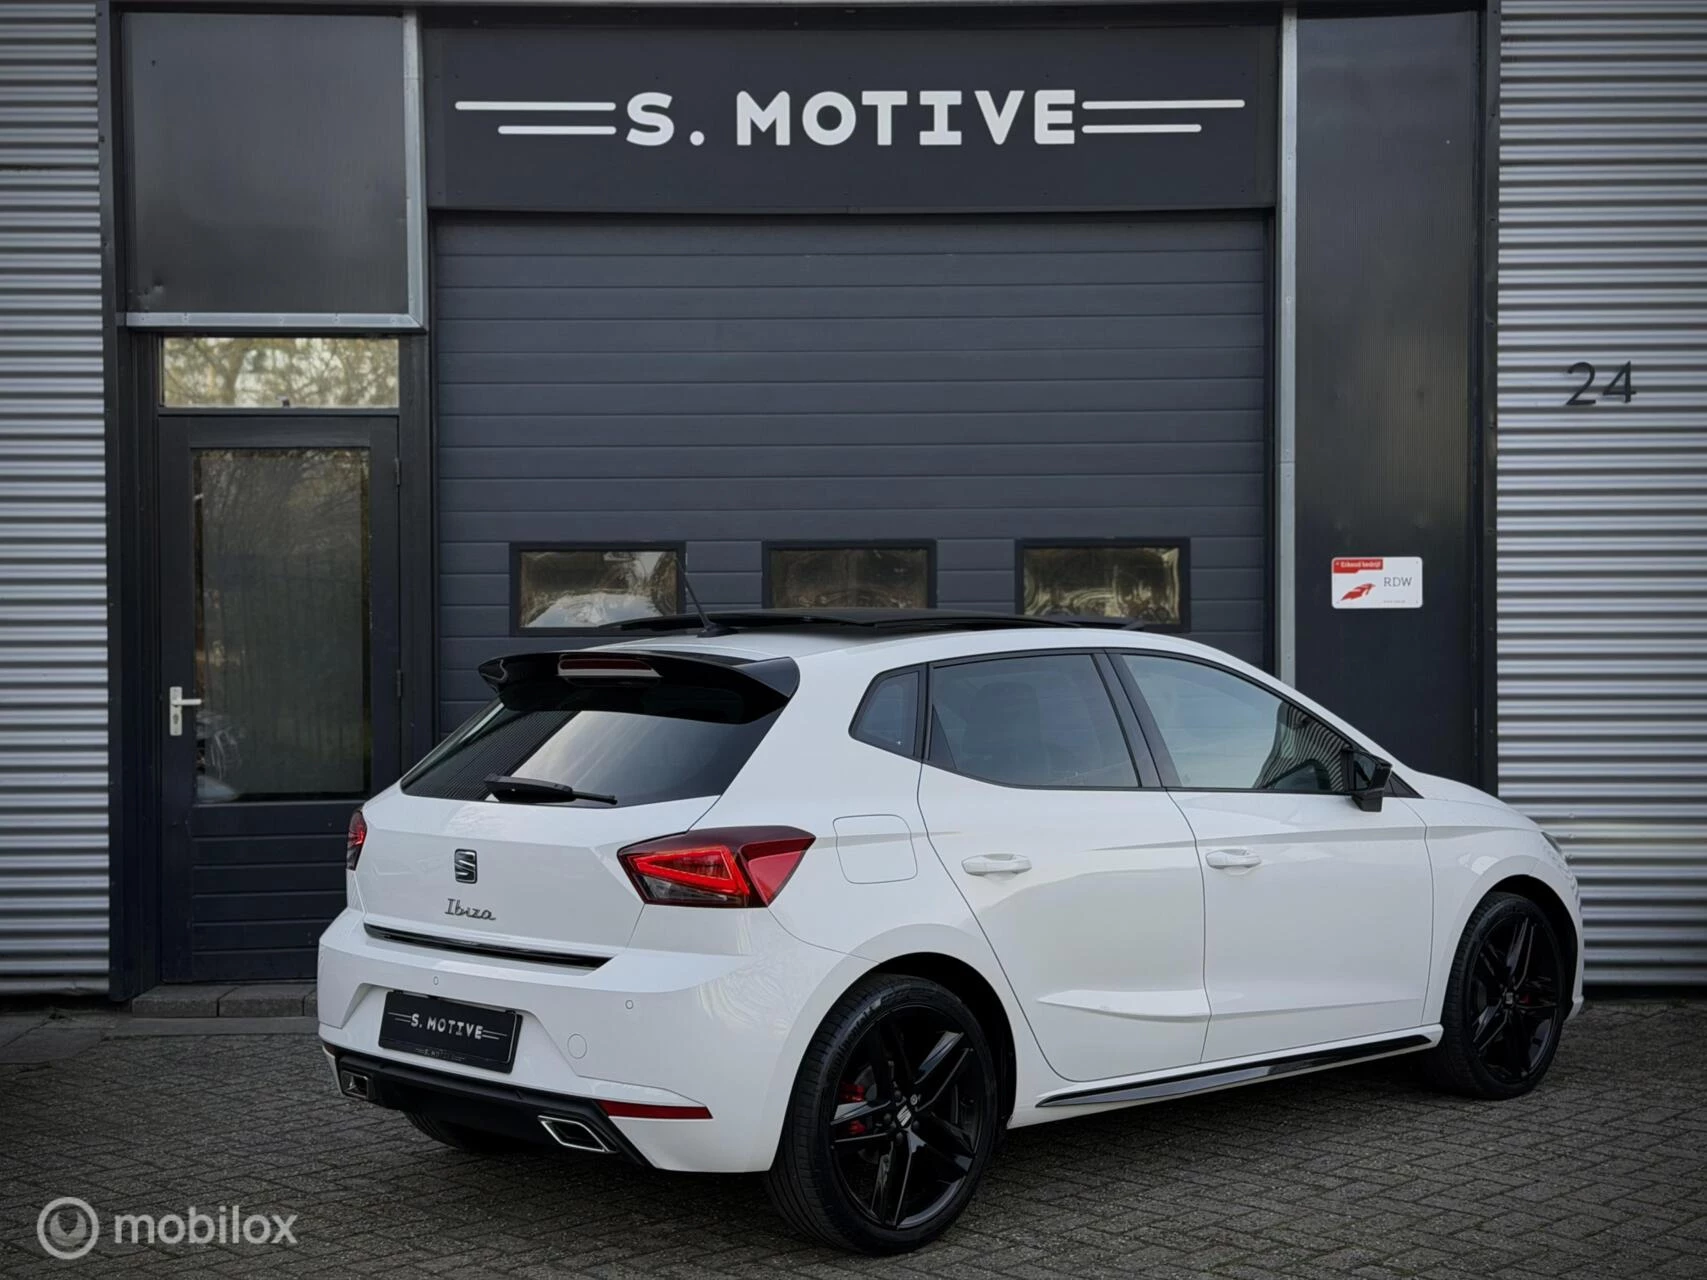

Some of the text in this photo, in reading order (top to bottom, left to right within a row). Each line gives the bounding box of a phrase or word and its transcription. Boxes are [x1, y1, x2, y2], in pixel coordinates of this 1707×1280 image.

[626, 90, 1076, 146] S. MOTIVE
[1566, 360, 1637, 406] 24
[1383, 576, 1413, 588] RDW
[445, 897, 497, 921] Ibiza
[410, 1013, 484, 1040] S. MOTIVE
